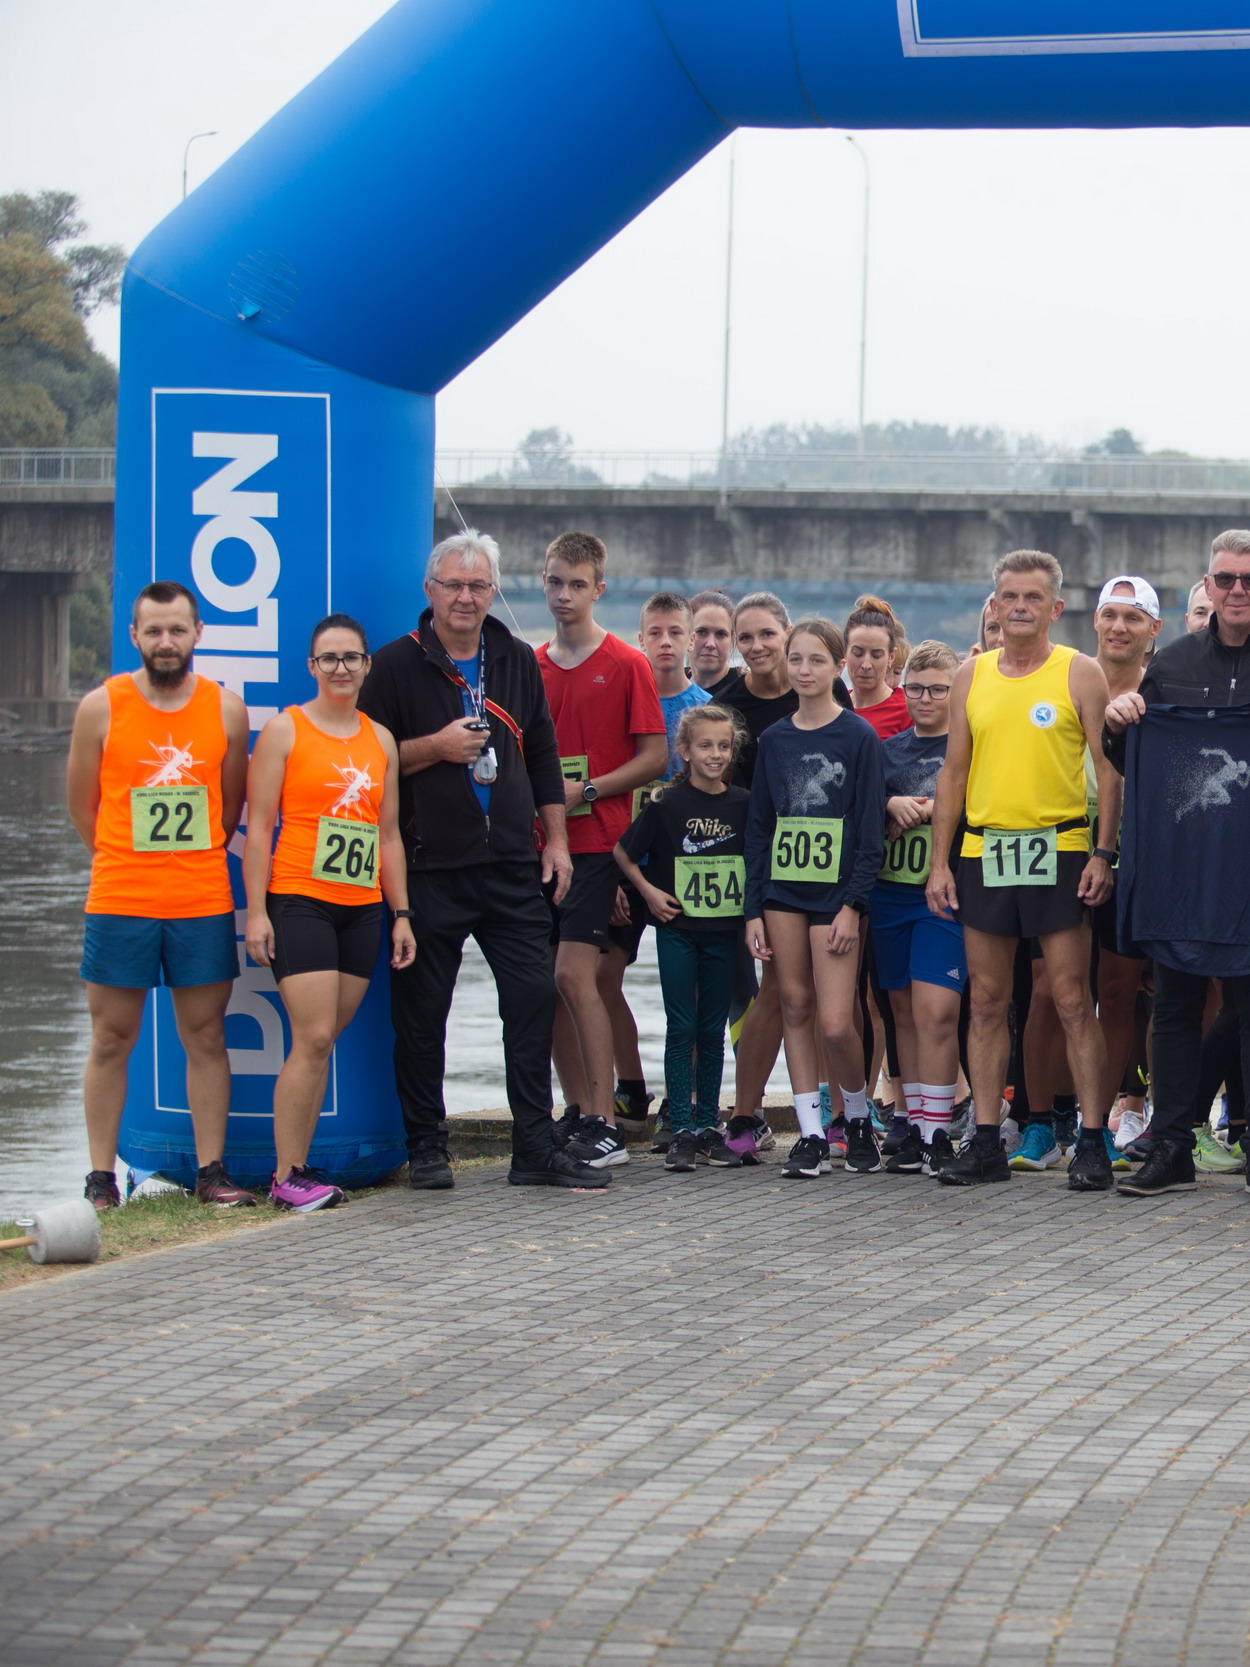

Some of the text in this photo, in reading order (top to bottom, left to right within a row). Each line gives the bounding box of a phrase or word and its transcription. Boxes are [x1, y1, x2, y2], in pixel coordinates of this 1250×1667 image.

[150, 802, 194, 842] 22
[686, 818, 733, 837] Nike
[322, 834, 375, 880] 264
[776, 830, 833, 870] 503
[990, 837, 1048, 877] 112
[683, 871, 743, 909] 454
